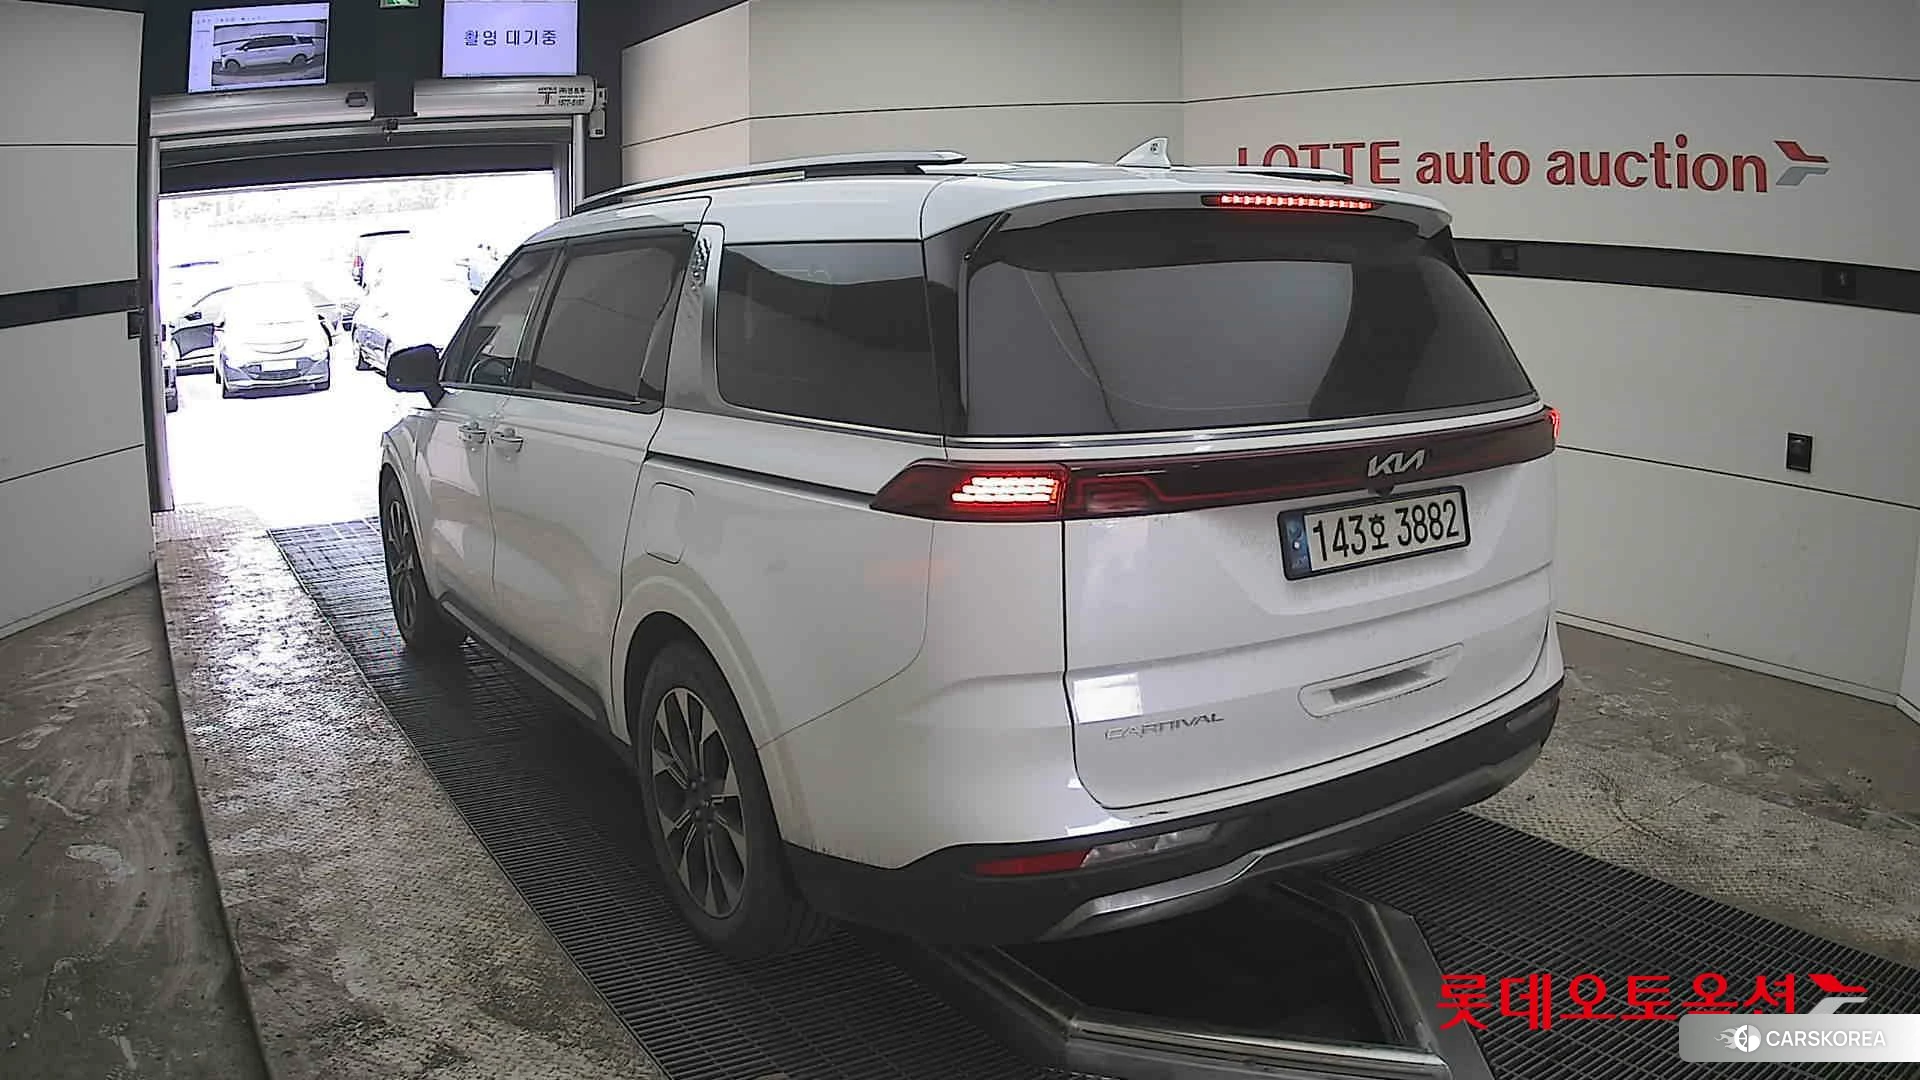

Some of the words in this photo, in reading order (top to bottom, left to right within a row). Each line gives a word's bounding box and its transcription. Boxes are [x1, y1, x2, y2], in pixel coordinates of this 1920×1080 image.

[505, 29, 557, 46] 대기중
[1415, 141, 1531, 186] auto
[1546, 134, 1768, 193] auction
[1312, 513, 1389, 561] 143호
[1395, 499, 1460, 546] 3882
[1104, 712, 1225, 740] CARNIVAL
